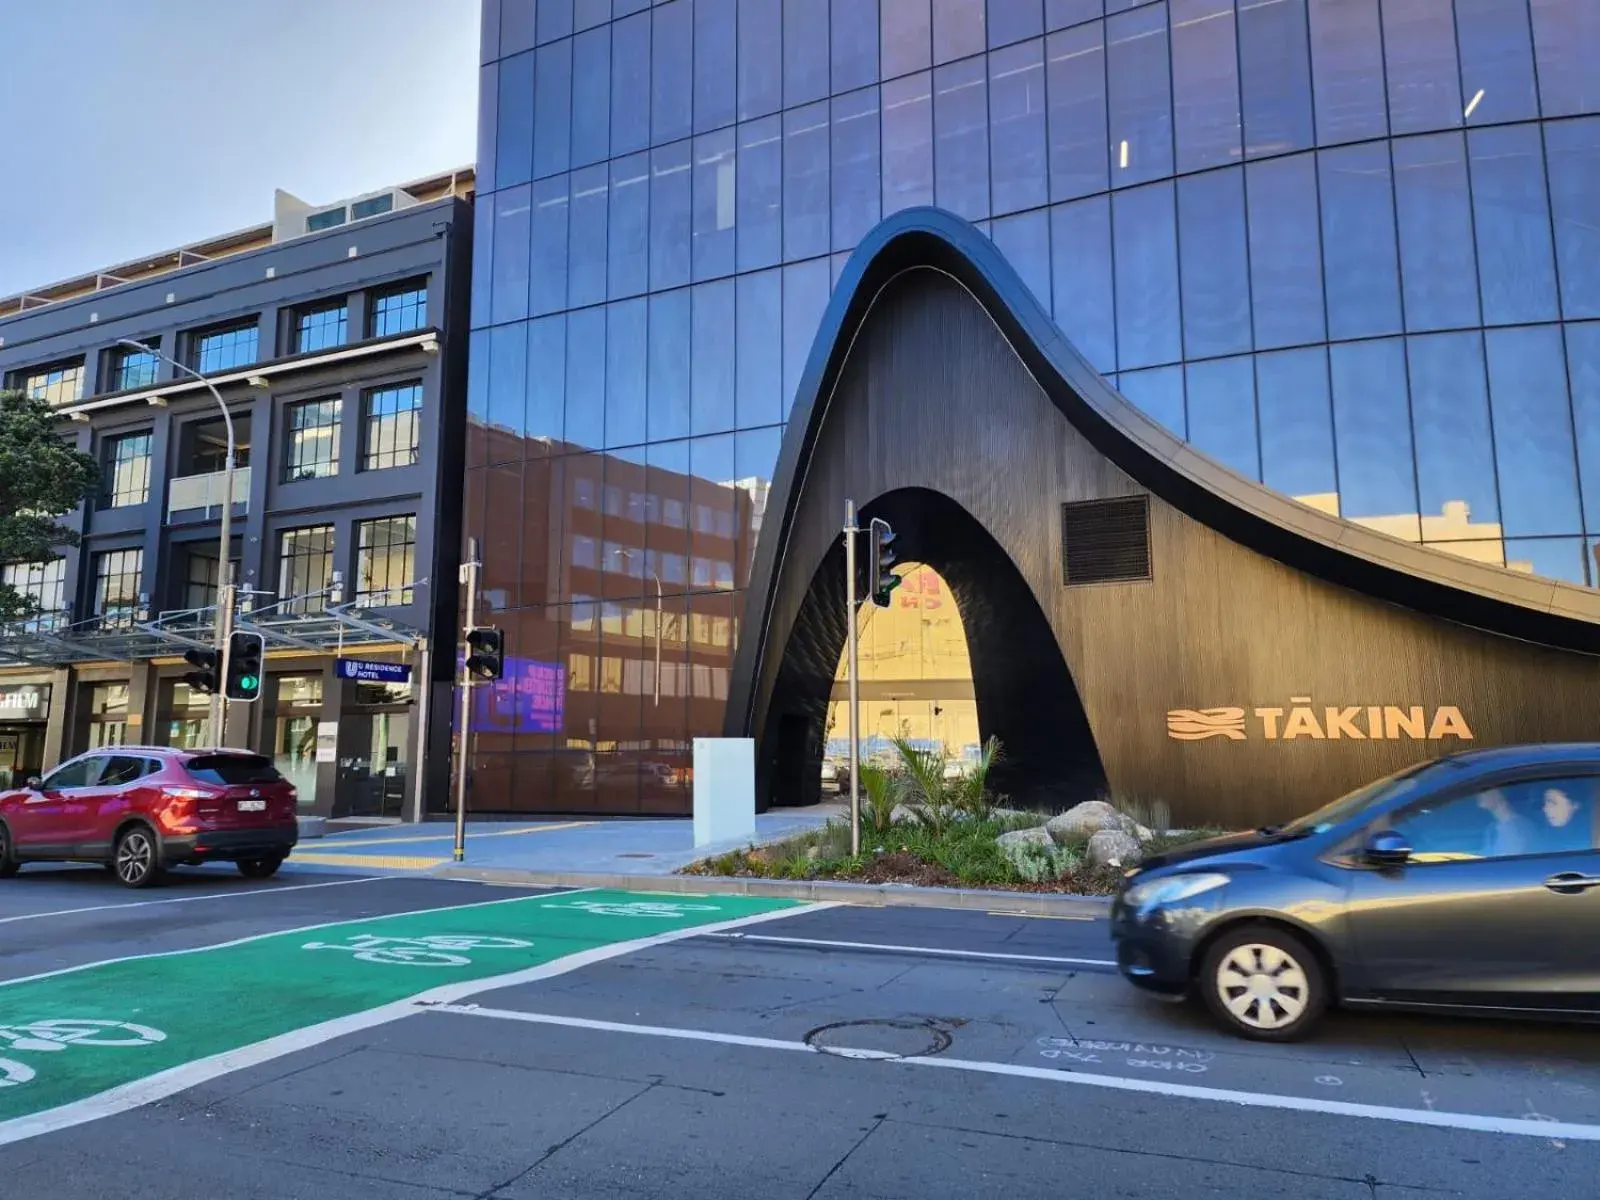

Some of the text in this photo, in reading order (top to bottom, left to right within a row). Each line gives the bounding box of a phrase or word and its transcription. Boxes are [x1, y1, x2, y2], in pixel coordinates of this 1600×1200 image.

[364, 663, 402, 673] RESIDENCE
[357, 671, 379, 679] HOTEL
[1255, 696, 1474, 740] TĀKINA
